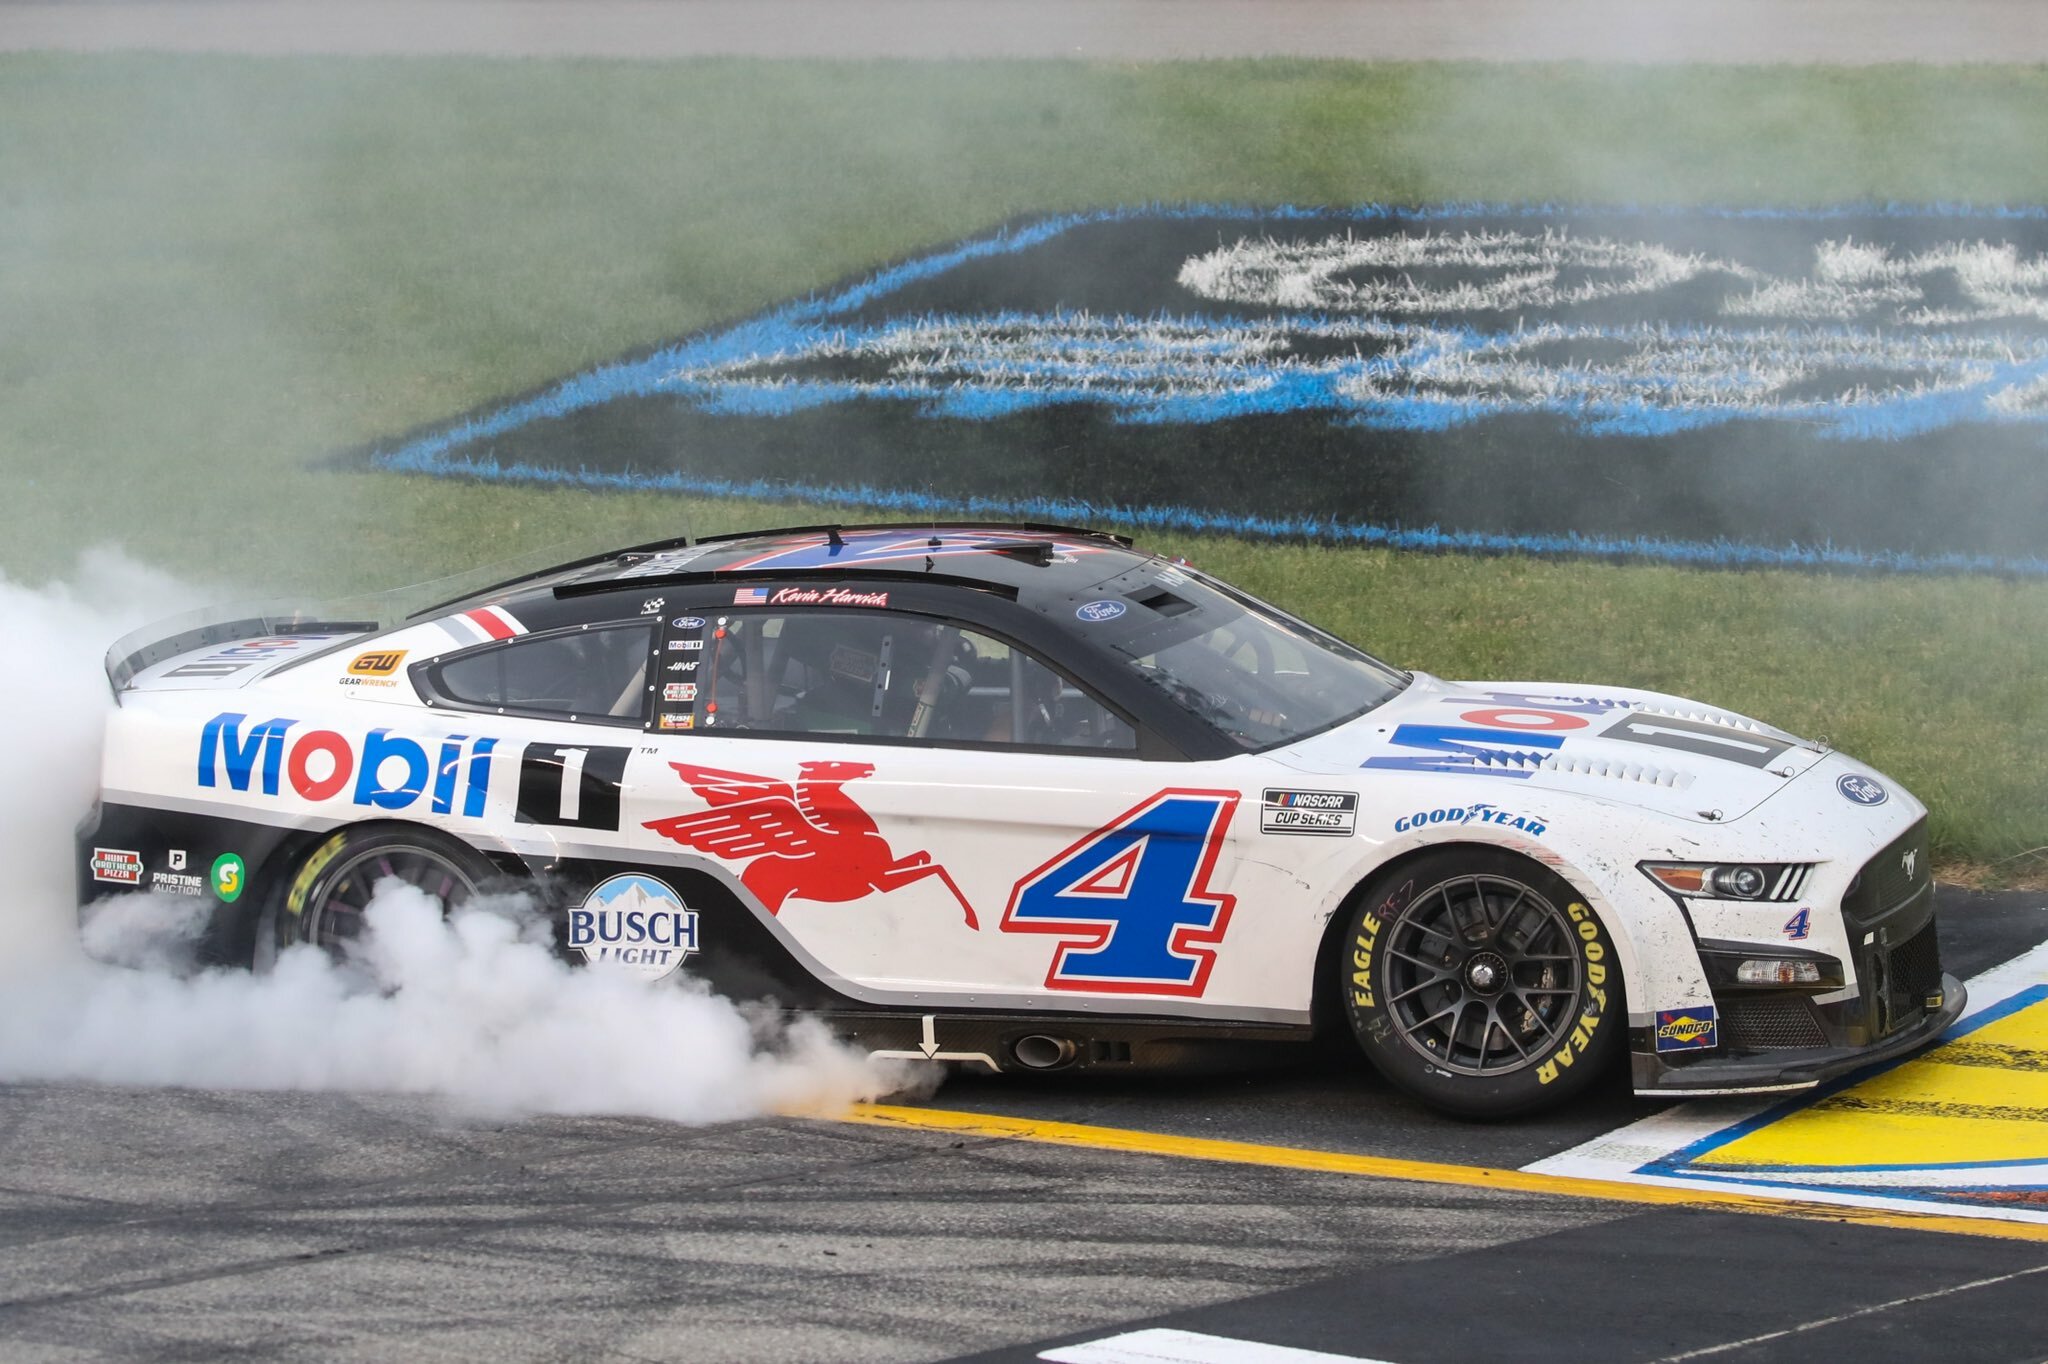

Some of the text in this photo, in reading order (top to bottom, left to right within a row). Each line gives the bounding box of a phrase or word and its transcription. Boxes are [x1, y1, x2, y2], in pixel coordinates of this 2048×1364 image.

[770, 587, 887, 607] Kevin Harvick
[353, 654, 400, 671] GW
[338, 677, 397, 688] GEARWRENCH
[198, 713, 500, 818] Mobil
[1293, 793, 1344, 809] NASCAR
[1275, 812, 1343, 826] CUP SERIES
[1394, 804, 1547, 837] GOODYEAR
[95, 860, 138, 872] BROTHERS
[104, 853, 129, 863] HUNT
[104, 869, 130, 879] PIZZA
[152, 872, 202, 887] PRISTINE
[153, 883, 202, 896] AUCTION
[999, 787, 1242, 998] 4
[570, 910, 696, 948] BUSCH
[1782, 907, 1810, 941] 4
[1353, 911, 1381, 1008] EAGLE
[1536, 902, 1607, 1085] GOODYEAR
[1659, 1020, 1714, 1037] SUNOCO
